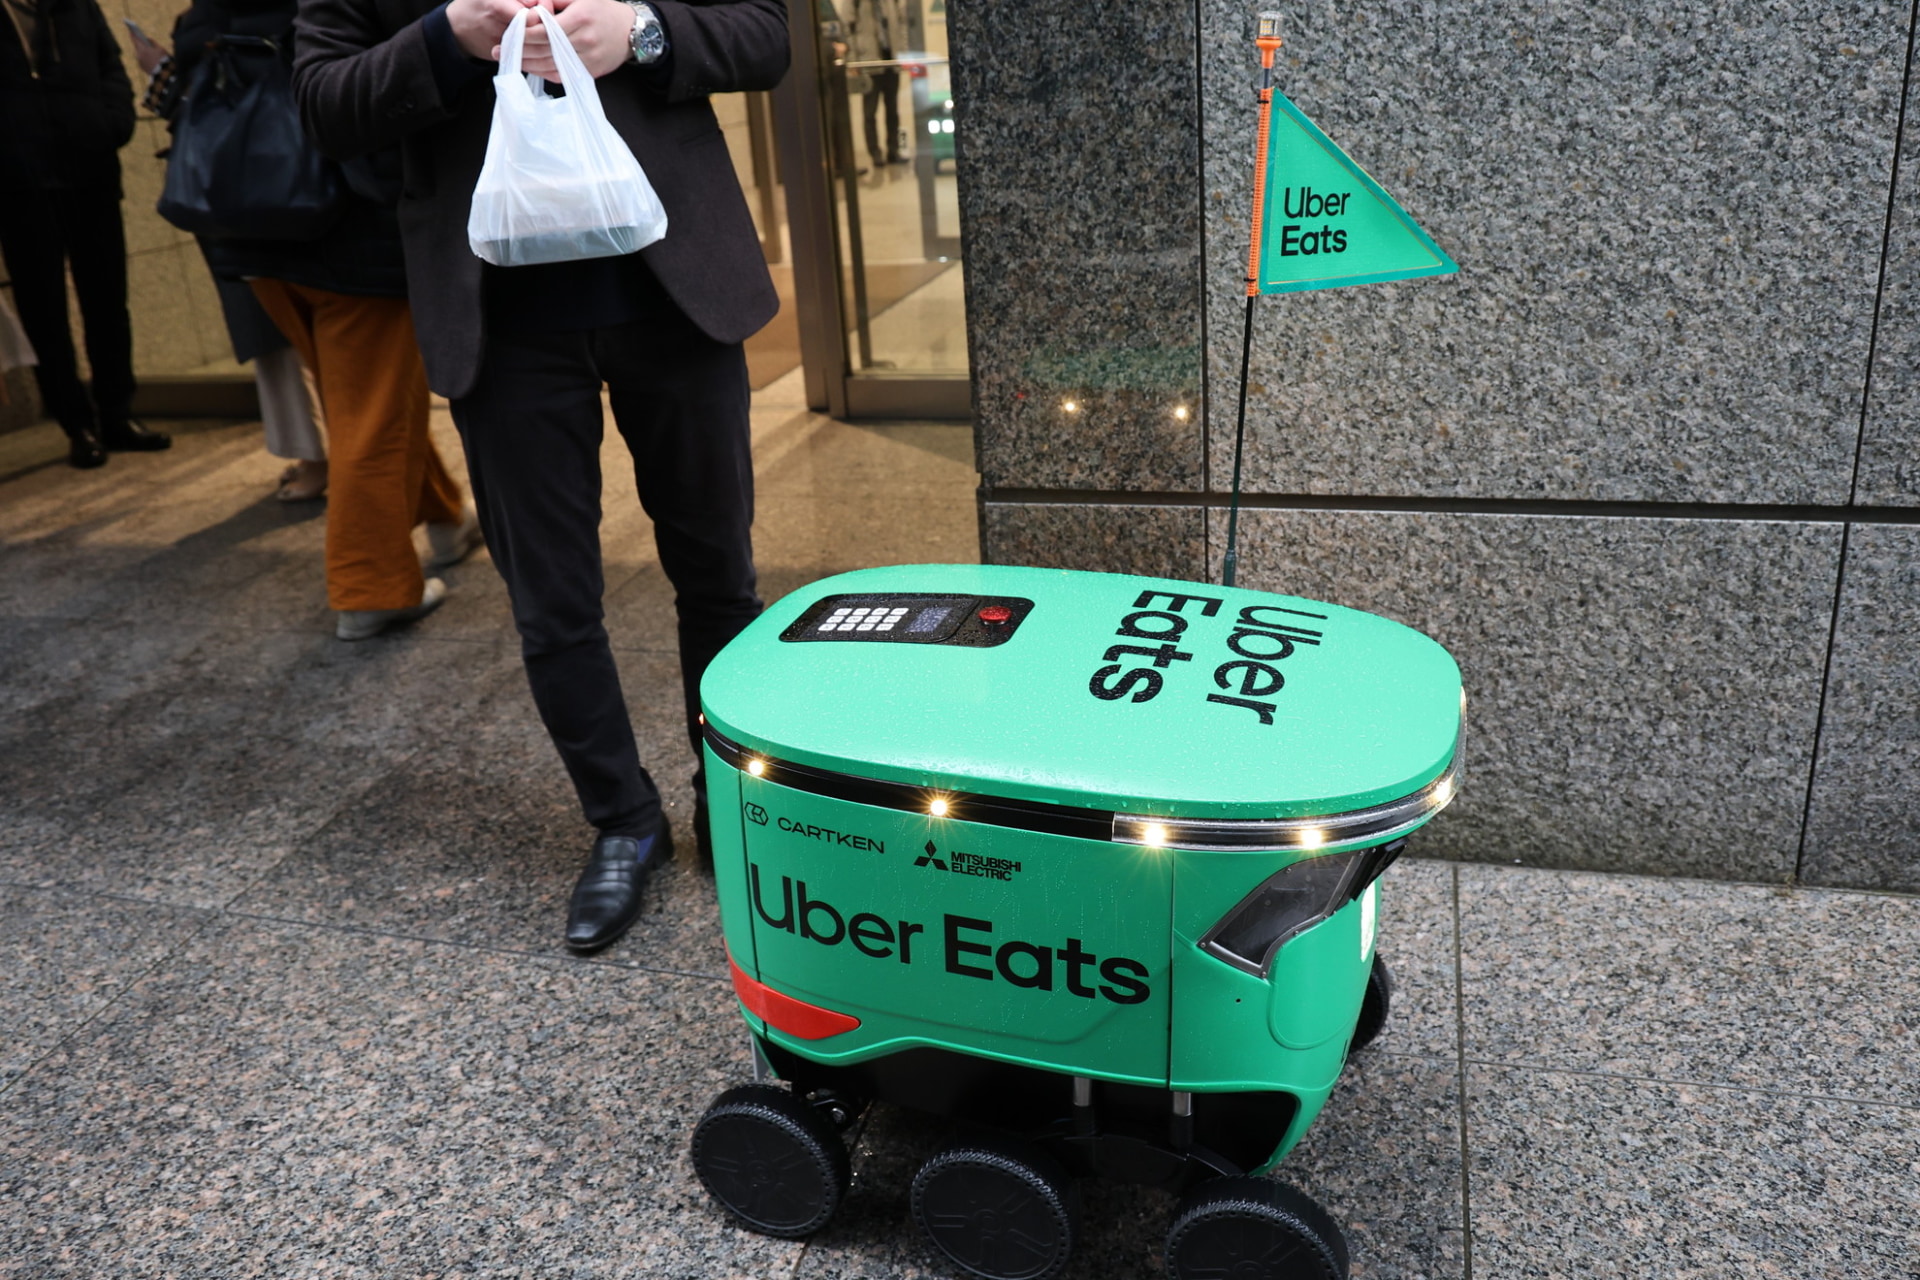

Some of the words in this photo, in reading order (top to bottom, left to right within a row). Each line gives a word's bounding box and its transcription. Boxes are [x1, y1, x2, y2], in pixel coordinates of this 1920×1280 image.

[1284, 186, 1351, 219] Uber
[1281, 225, 1347, 256] Eats
[1089, 590, 1224, 703] Eats
[1206, 605, 1328, 725] Uber
[778, 816, 885, 854] CARTKEN
[950, 850, 1022, 873] MITSUBISHI
[950, 863, 1013, 882] ELECTRIC
[750, 863, 923, 965] Uber
[943, 913, 1151, 1005] Eats
